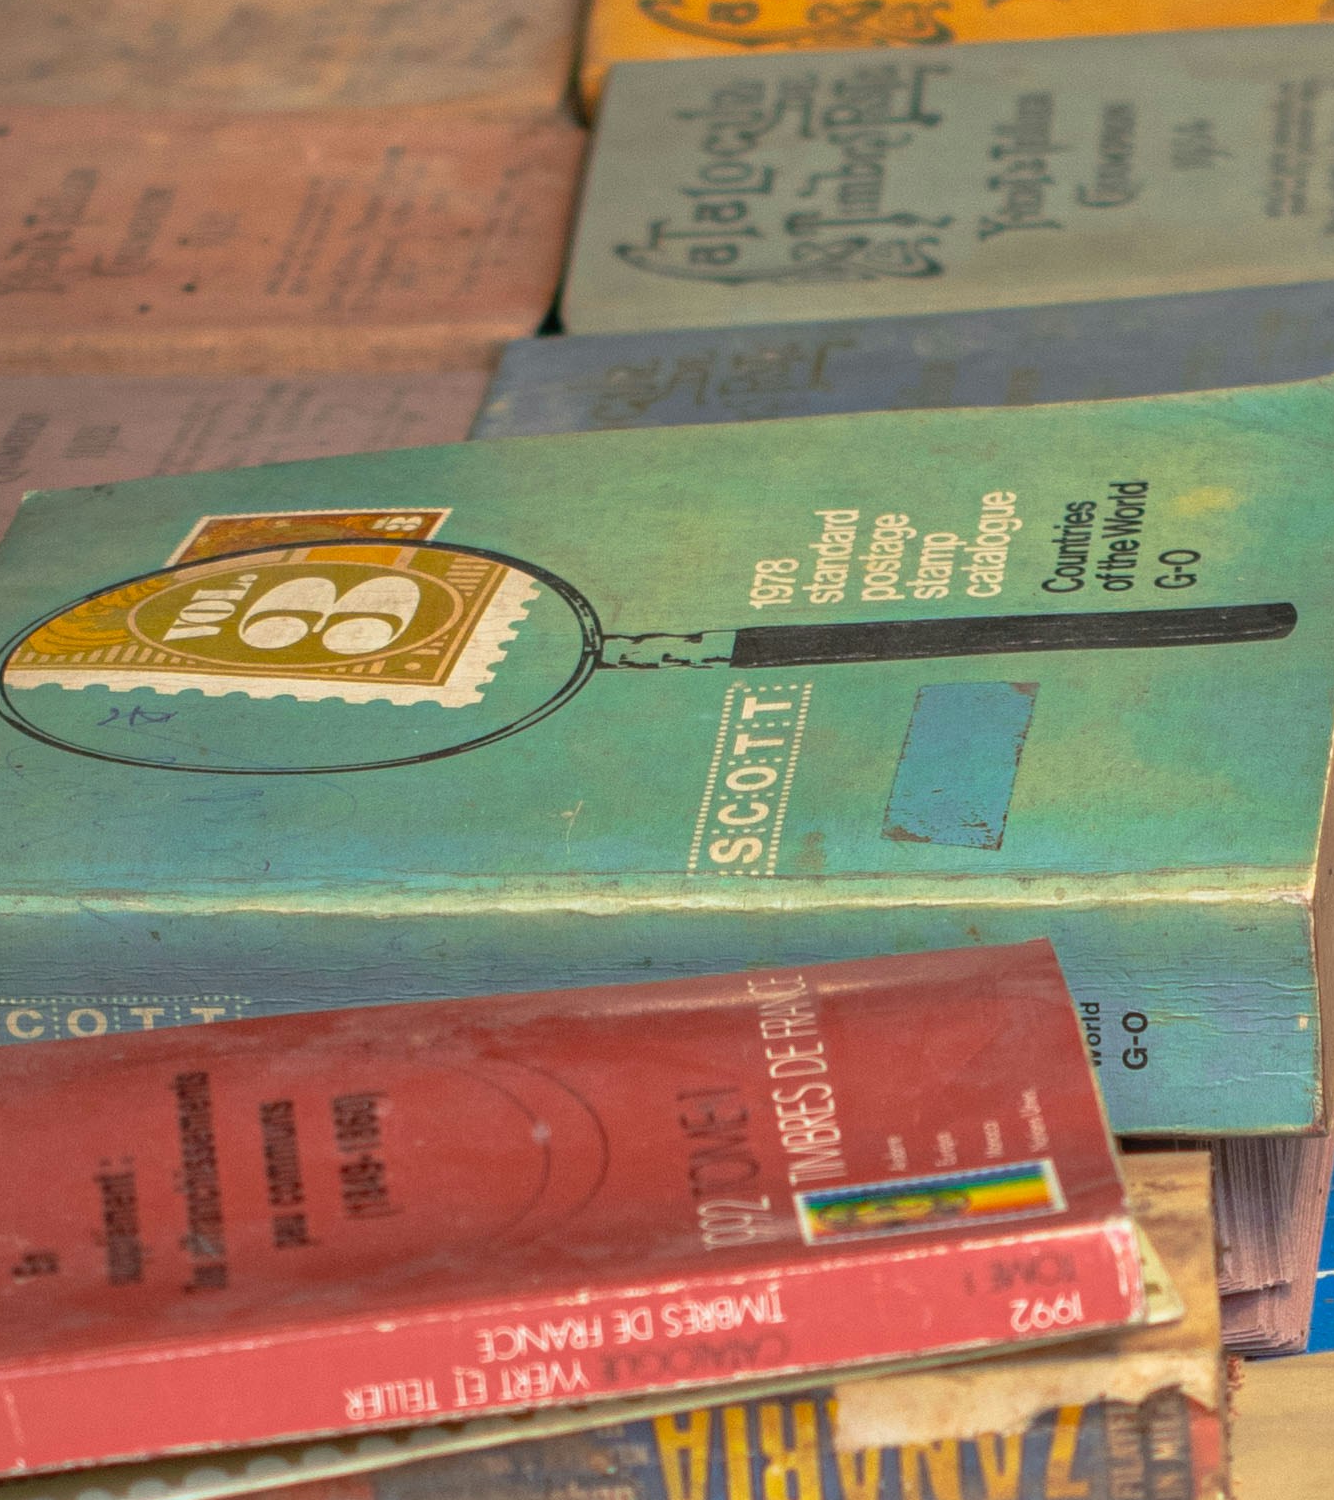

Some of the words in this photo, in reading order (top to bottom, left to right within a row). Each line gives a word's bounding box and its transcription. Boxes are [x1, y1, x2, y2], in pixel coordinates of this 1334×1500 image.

[1103, 480, 1149, 539] World
[804, 509, 859, 605] standard
[860, 514, 914, 602] postage
[915, 532, 959, 600] stamp
[965, 490, 1020, 598] catalogue
[1043, 500, 1097, 596] Countries
[1100, 539, 1139, 573] the
[1155, 549, 1201, 590] G-O
[163, 573, 260, 642] VOL.
[750, 558, 798, 609] 1978
[1099, 573, 1134, 592] of
[238, 576, 423, 656] 3
[708, 692, 794, 867] SCOTT
[751, 973, 818, 1041] FRANCE
[768, 1041, 830, 1080] DE
[1122, 1010, 1149, 1071] G-O
[770, 1082, 848, 1187] TIMBRES
[696, 1196, 774, 1252] 1992
[478, 1308, 605, 1361] FRANCE
[615, 1306, 656, 1344] DE
[664, 1282, 786, 1338] TIMBRES
[1011, 1297, 1082, 1332] 1992
[344, 1371, 438, 1422] TELLIER
[454, 1365, 488, 1407] ET
[501, 1353, 588, 1403] YVERT
